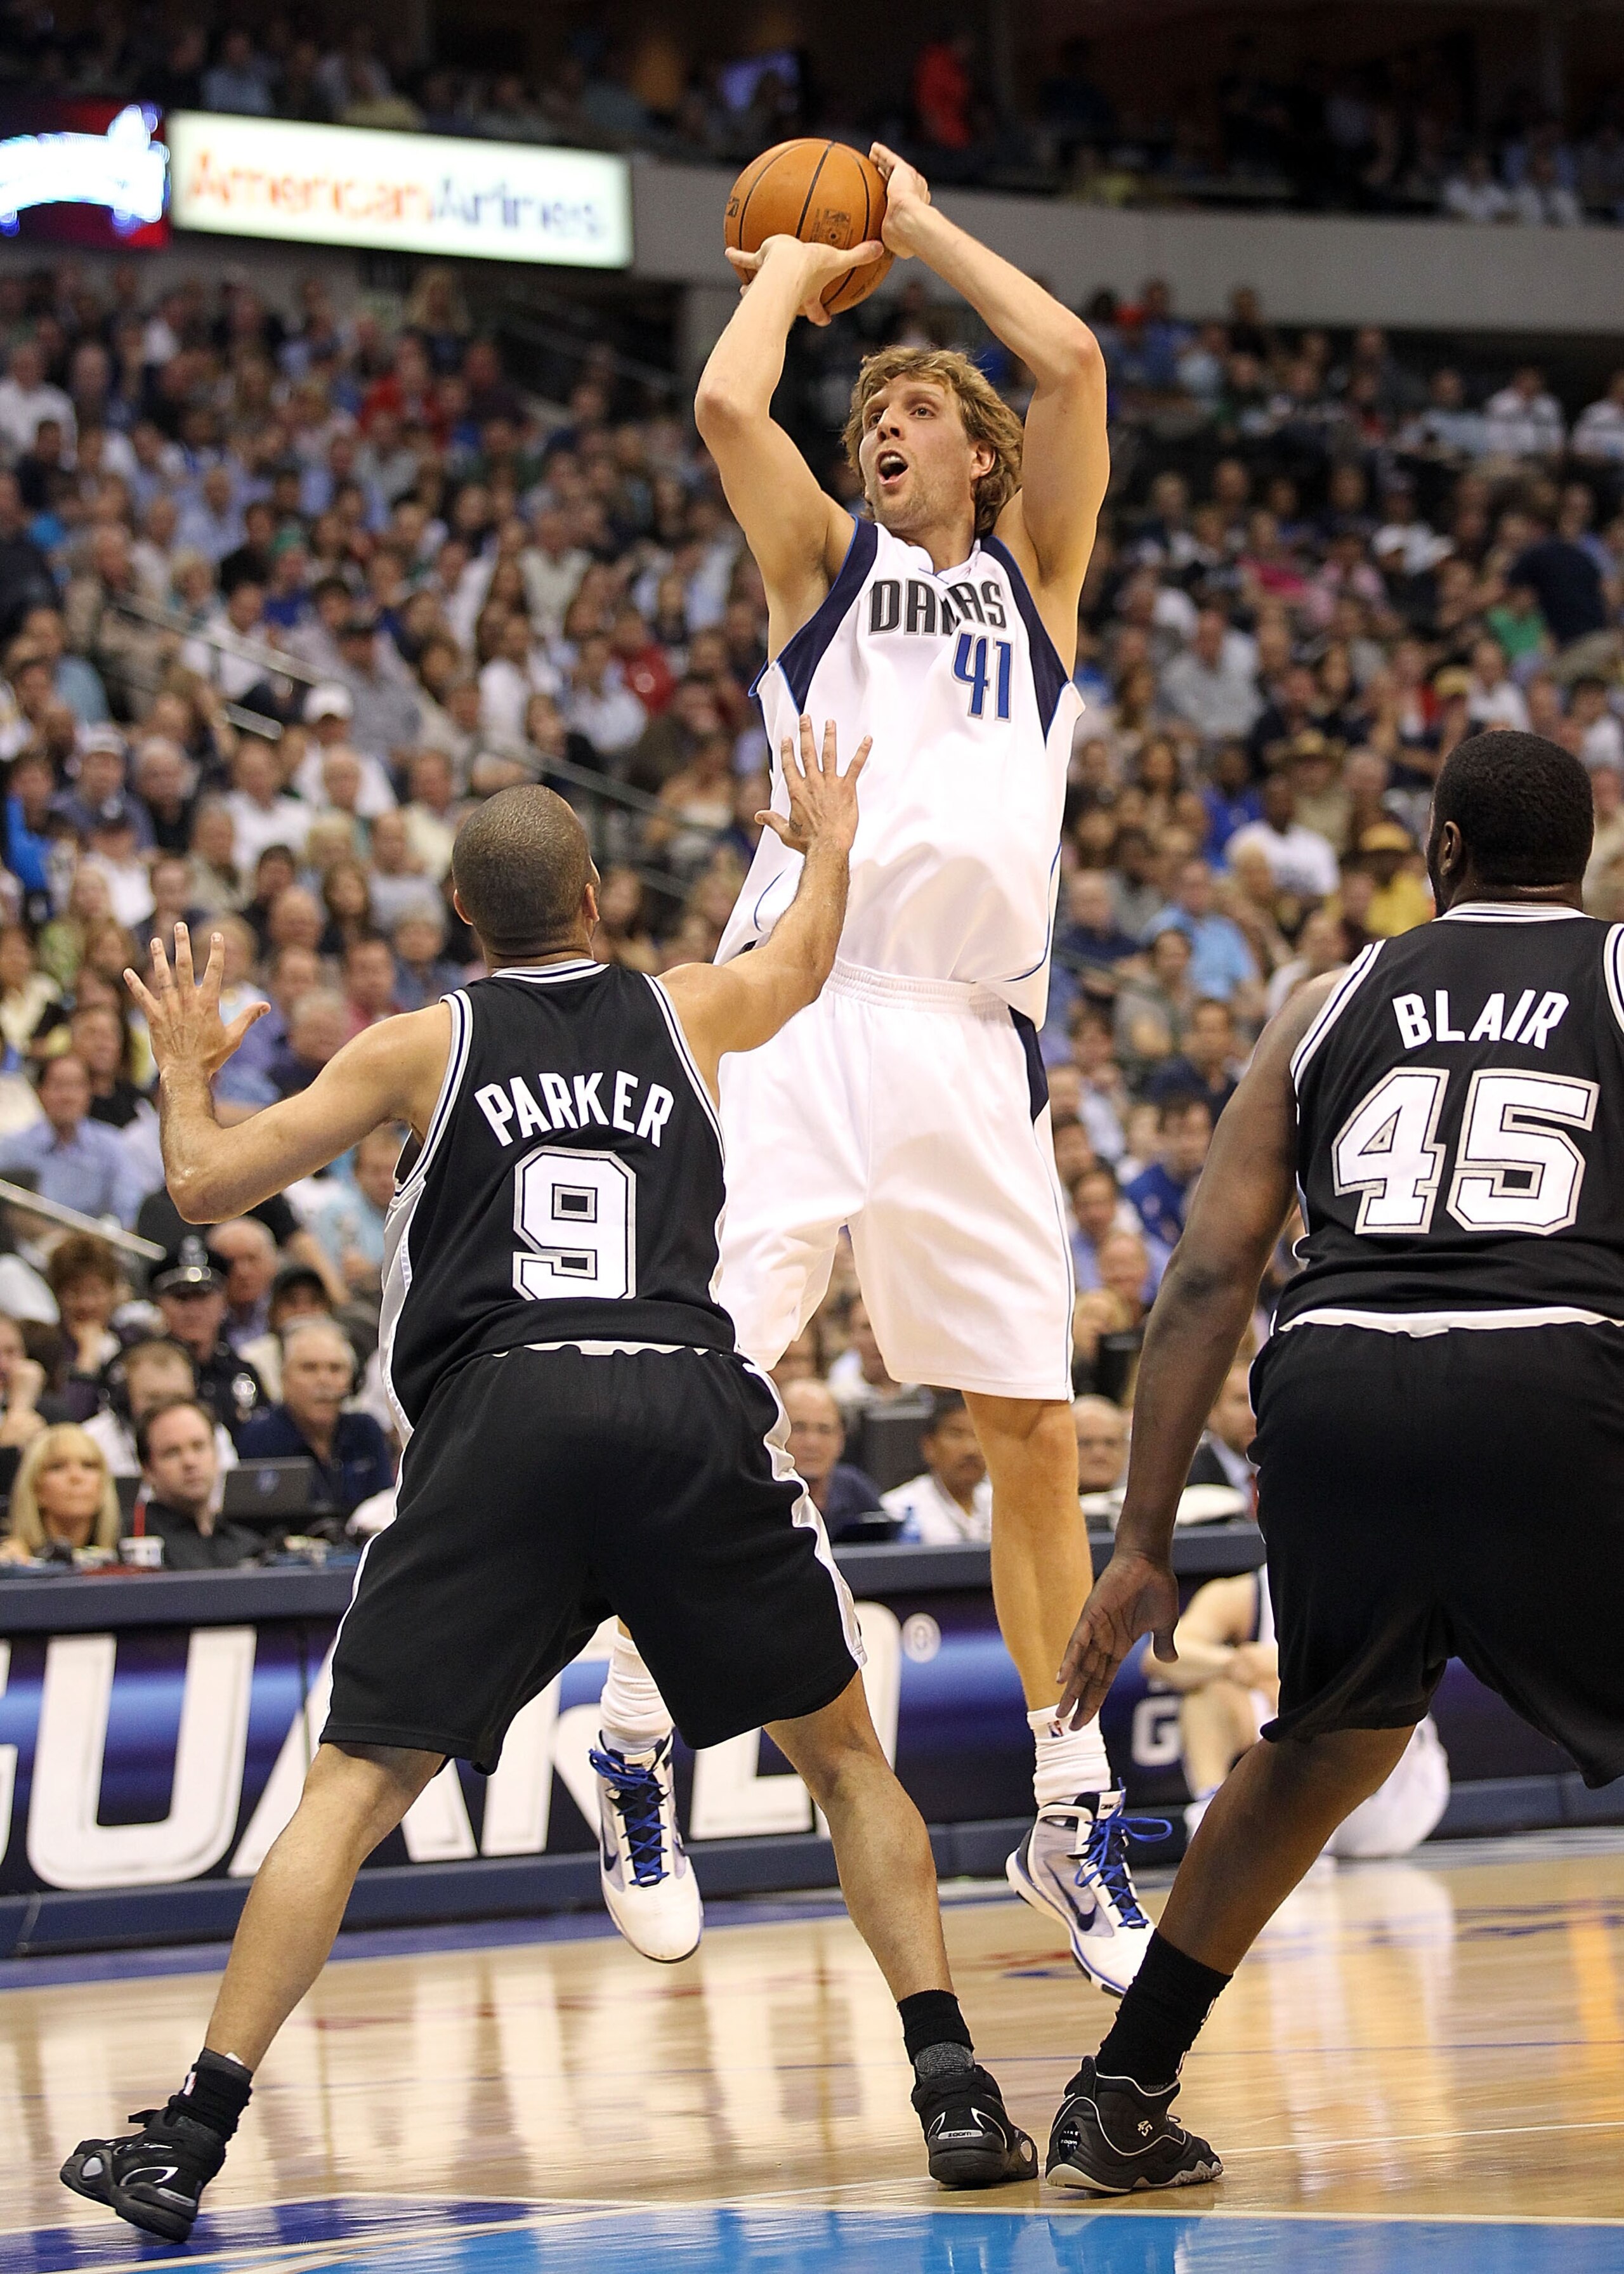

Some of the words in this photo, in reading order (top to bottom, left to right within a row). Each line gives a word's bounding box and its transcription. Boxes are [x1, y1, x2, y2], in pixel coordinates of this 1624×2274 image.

[952, 631, 1013, 722] 41
[1392, 989, 1569, 1049] BLAIR
[474, 1070, 674, 1147] PARKER
[1332, 1067, 1601, 1236] 45
[513, 1146, 636, 1301] 9
[1137, 2120, 1153, 2136] 45
